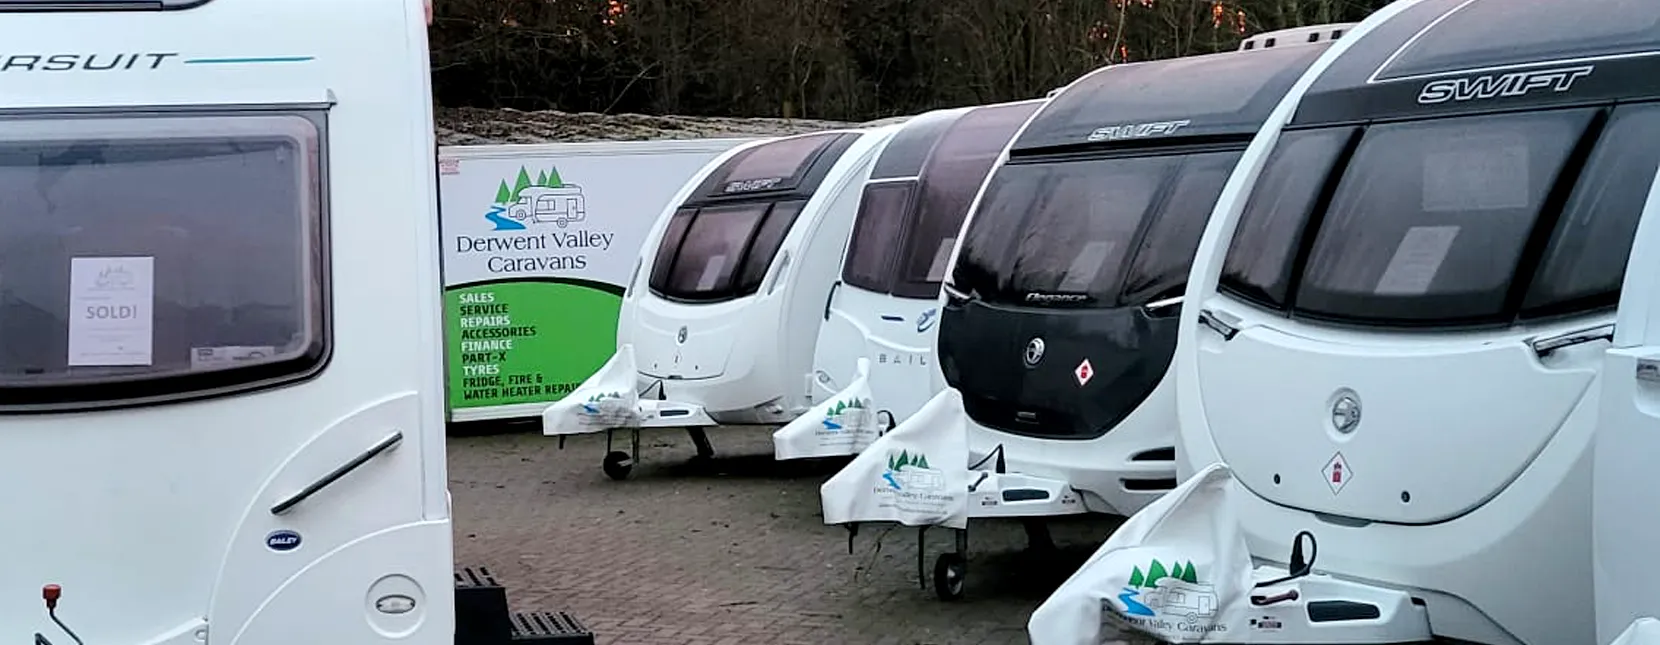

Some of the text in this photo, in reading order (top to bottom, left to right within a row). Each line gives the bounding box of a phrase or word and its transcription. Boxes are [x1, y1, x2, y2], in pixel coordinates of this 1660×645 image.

[0, 53, 179, 71] RSUIT
[1418, 65, 1594, 104] SWIFT
[1087, 119, 1191, 141] SWIFT
[456, 231, 614, 253] Derwent Valley
[487, 254, 587, 273] Caravans
[460, 292, 495, 304] SALES
[85, 304, 137, 320] SOLD!
[460, 304, 509, 316] SERVICE
[460, 315, 511, 328] REPAIRS
[461, 326, 537, 340] ACCESSORIES
[461, 339, 513, 352] FINANCE
[462, 351, 507, 364] PART-X
[463, 363, 500, 376] TYRES
[463, 373, 543, 388] FRIDGE, FIRE &
[464, 388, 498, 401] WATER
[502, 385, 542, 398] HEATER
[1177, 621, 1228, 634] Caravans
